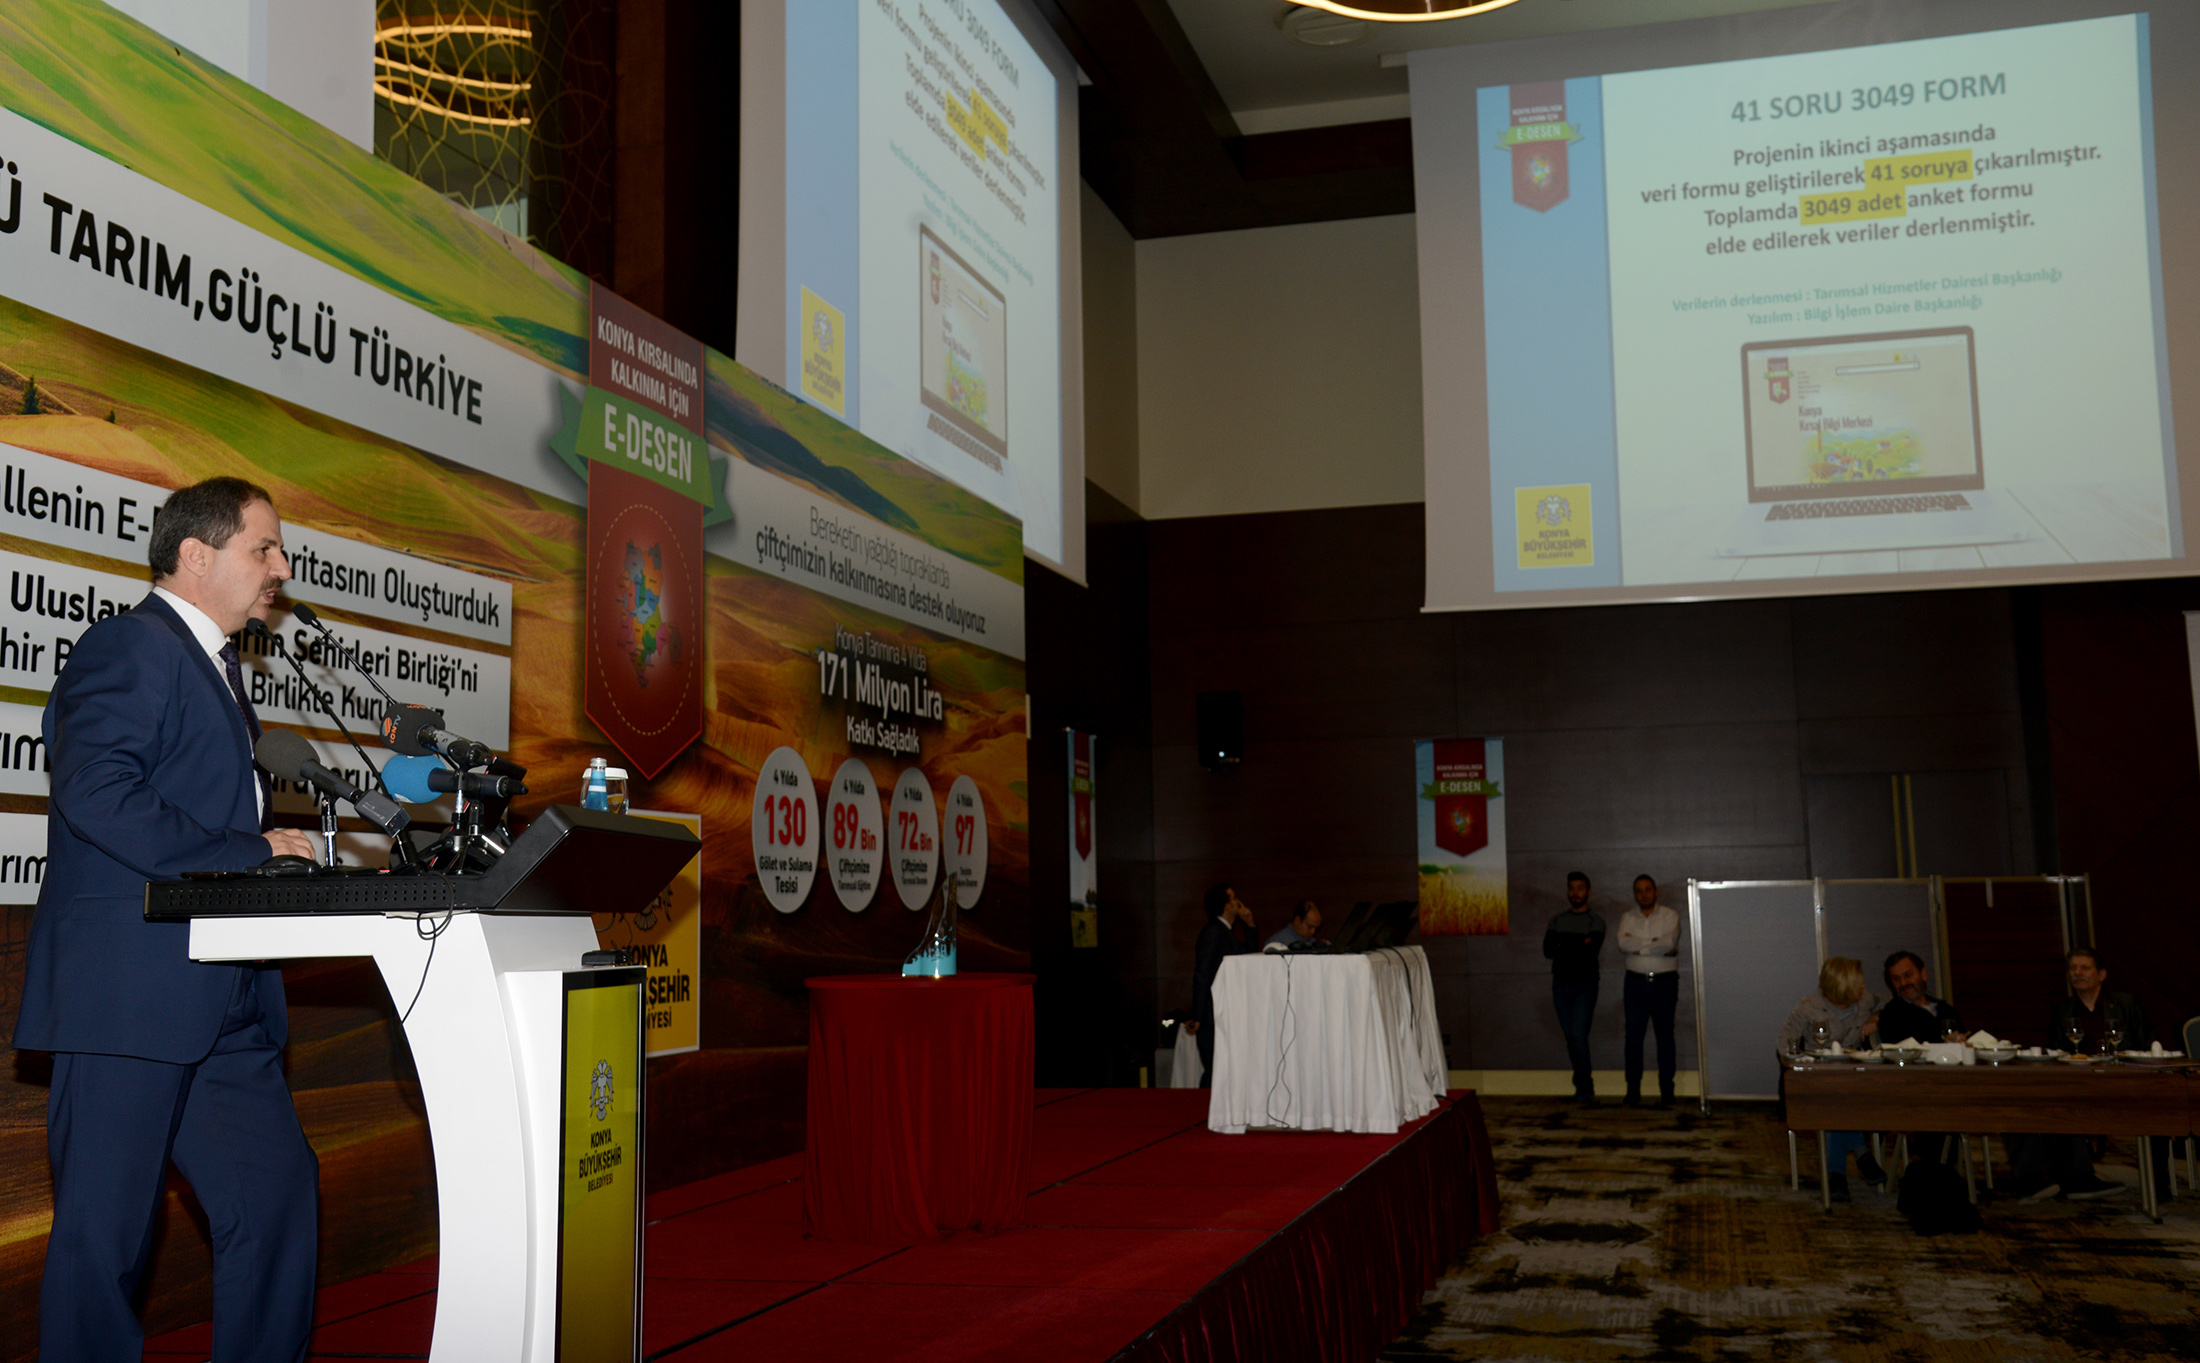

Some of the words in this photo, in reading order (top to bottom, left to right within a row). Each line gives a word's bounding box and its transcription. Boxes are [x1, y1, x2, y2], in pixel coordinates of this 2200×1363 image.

[1730, 100, 1761, 123] 41
[1770, 91, 1842, 120] SORU
[1851, 83, 1915, 112] 3049
[1924, 73, 2007, 103] FORM
[1733, 143, 1814, 167] Projenin
[1820, 137, 1871, 159] ikinci
[1876, 124, 1997, 155] aşamasında
[1641, 184, 1676, 204] veri
[1682, 178, 1740, 200] formu
[1745, 165, 1866, 195] geliştirilerek
[1870, 164, 1895, 183] 41
[1900, 159, 1969, 183] soruya
[1973, 143, 2102, 176] çıkarılmıştır.
[1704, 204, 1799, 230] Toplamda
[1803, 199, 1852, 219] 3049
[1857, 194, 1902, 214] adet
[1907, 186, 1965, 208] anket
[1970, 181, 2034, 202] formu
[1705, 237, 1747, 256] elde
[1752, 228, 1831, 252] edilerek
[1836, 222, 1900, 244] veriler
[1905, 210, 2035, 240] derlenmiştir.
[598, 315, 635, 357] KONYA
[637, 336, 698, 390] KIRSALINDA
[349, 326, 483, 425] TÜRKİYE
[611, 358, 667, 407] KALKINMA
[668, 381, 689, 418] İÇİN
[605, 402, 692, 484] E-DESEN
[810, 505, 863, 556] Bereketin
[900, 545, 950, 589] topraklarda
[384, 566, 500, 628] Oluşturduk
[756, 525, 826, 578] çiftçimizin
[830, 550, 907, 607] kalkınmasına
[909, 583, 944, 620] destek
[945, 598, 986, 635] oluyoruz
[836, 622, 864, 659] Konya
[251, 670, 335, 708] Birlikte
[396, 648, 479, 698] Birliği'ni
[818, 650, 848, 699] 171
[855, 659, 911, 721] Milyon
[914, 675, 943, 721] Lira
[846, 714, 875, 746] Katkı
[877, 720, 920, 757] Sağladık
[774, 769, 779, 784] 4
[780, 769, 799, 787] Yılda
[849, 780, 865, 795] Yılda
[1440, 780, 1482, 794] E-DESEN
[764, 794, 806, 847] 130
[833, 801, 858, 850] 89
[861, 828, 877, 851] Bin
[898, 810, 919, 850] 72
[920, 832, 933, 851] Bin
[955, 814, 975, 855] 97
[759, 855, 778, 871] Gölet
[779, 861, 787, 871] ve
[789, 857, 813, 872] Sulama
[775, 875, 799, 893] Tesisi
[622, 943, 669, 968] ONYA
[646, 968, 690, 1009] ŞEHİR
[590, 1127, 612, 1149] KONYA
[578, 1143, 622, 1179] BÜYÜKŞEHİR
[587, 1171, 613, 1193] BELEDİYESİ
